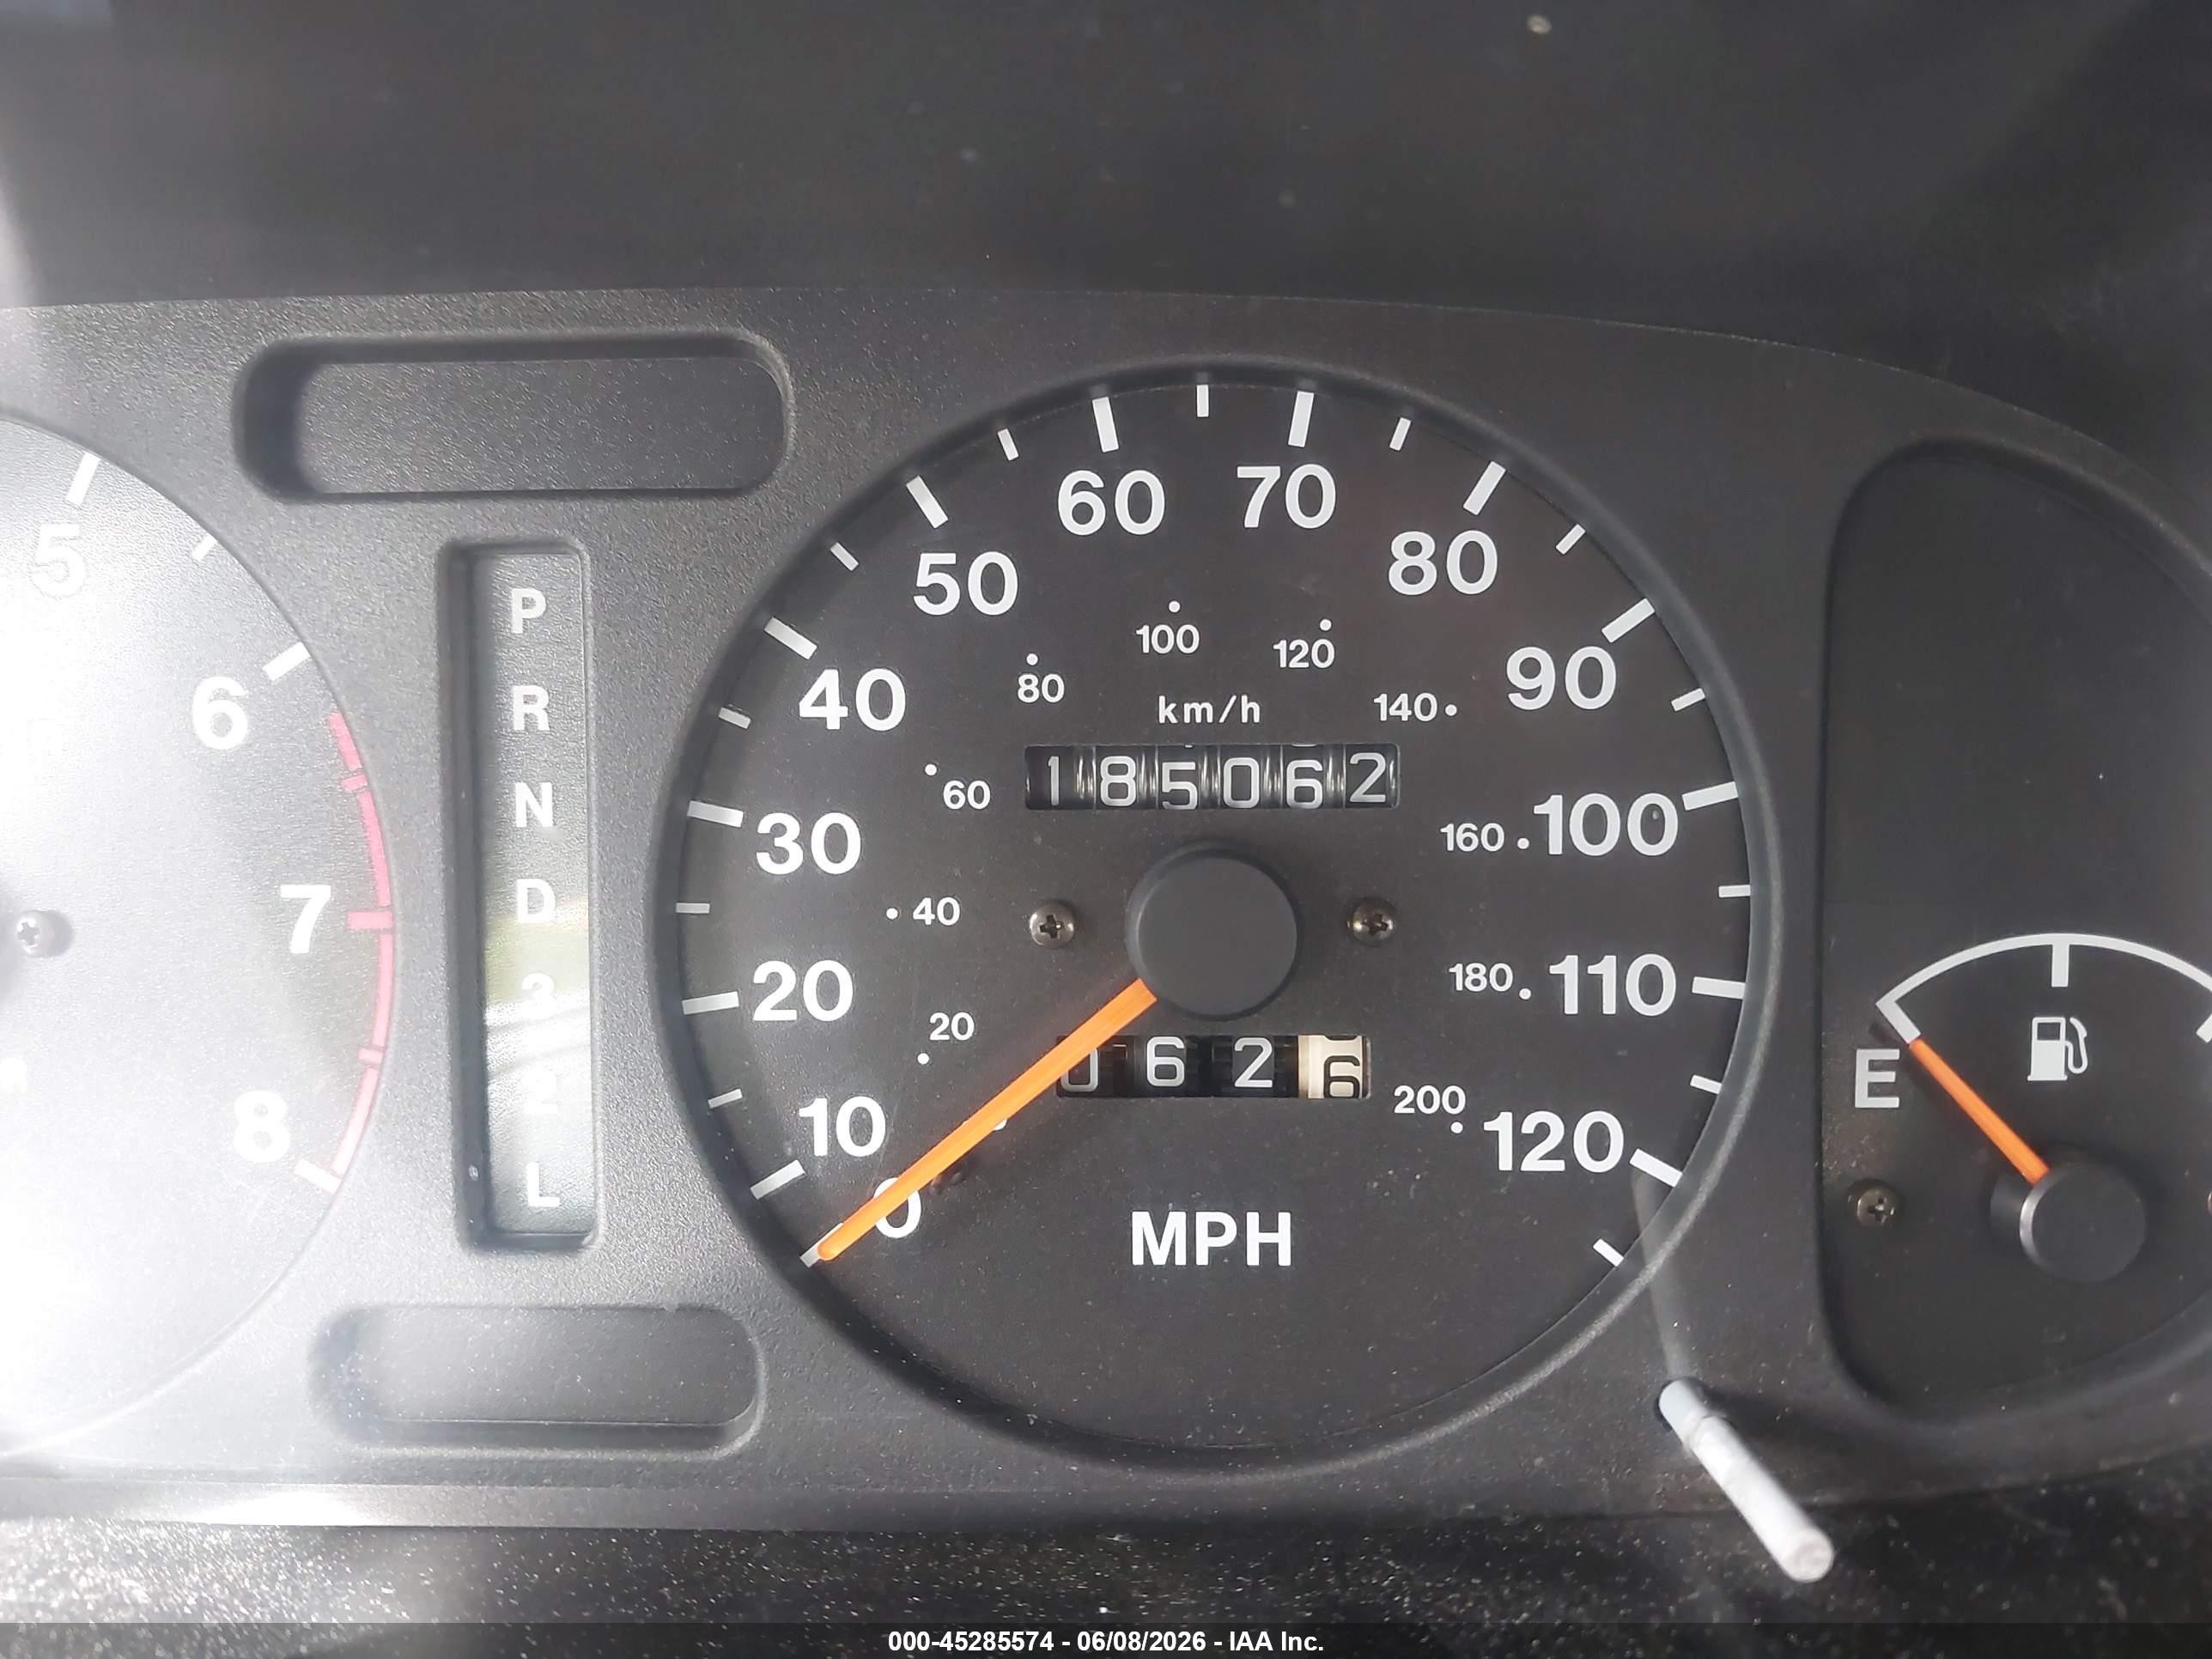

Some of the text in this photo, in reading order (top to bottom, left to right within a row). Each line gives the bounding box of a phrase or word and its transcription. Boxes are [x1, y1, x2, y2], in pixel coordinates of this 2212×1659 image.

[1058, 471, 1164, 535] 60
[1237, 464, 1335, 528] 70
[31, 522, 86, 599] 5
[914, 551, 1018, 615] 50
[1389, 531, 1498, 595] 80
[511, 587, 545, 634] P
[1136, 624, 1199, 653] 100
[1273, 639, 1334, 668] 120
[1507, 647, 1616, 709] 90
[192, 675, 248, 750] 6
[512, 685, 550, 731] R
[799, 669, 905, 731] 40
[1018, 674, 1064, 702] 80
[1159, 695, 1260, 723] km/h
[1374, 693, 1437, 722] 140
[515, 781, 554, 827] N
[944, 781, 990, 809] 60
[1048, 752, 1386, 809] 185062
[757, 812, 860, 875] 30
[1441, 823, 1504, 851] 160
[1534, 793, 1678, 855] 100
[280, 884, 331, 954] 7
[517, 878, 556, 923] D
[913, 897, 960, 926] 40
[749, 960, 855, 1022] 20
[1449, 963, 1513, 991] 180
[1550, 954, 1676, 1016] 110
[930, 1012, 975, 1040] 20
[1395, 1085, 1465, 1114] 200
[1855, 1048, 1900, 1109] E
[233, 1090, 290, 1164] 8
[799, 1096, 886, 1158] 10
[1484, 1111, 1624, 1172] 120
[526, 1162, 560, 1206] L
[1133, 1212, 1291, 1266] MPH
